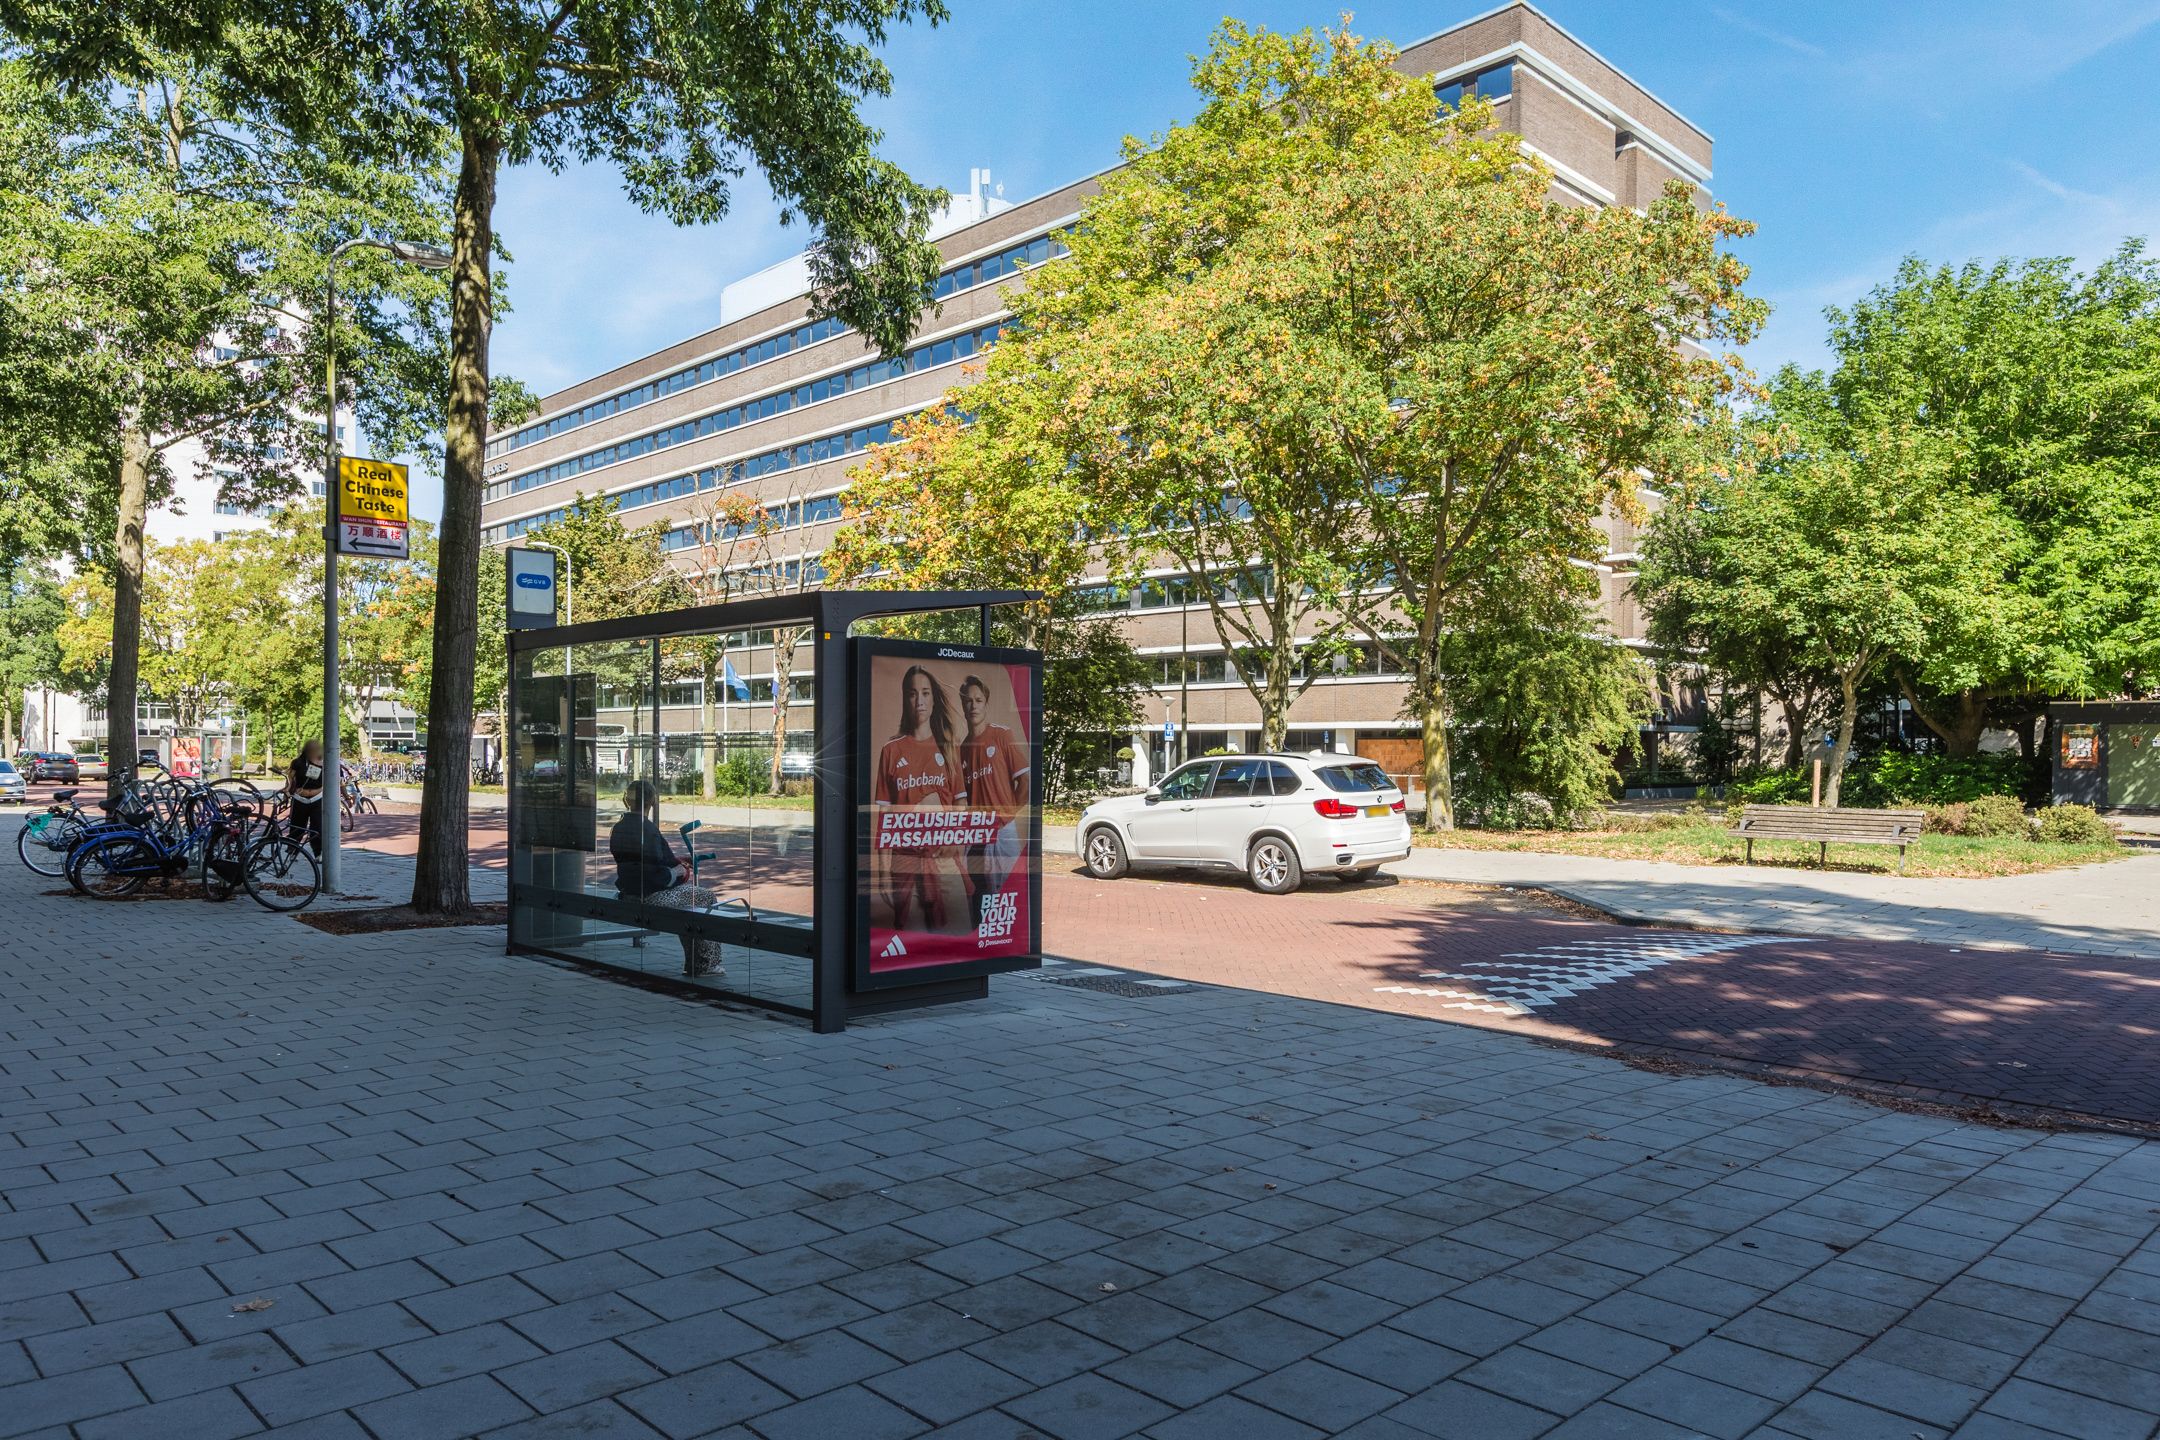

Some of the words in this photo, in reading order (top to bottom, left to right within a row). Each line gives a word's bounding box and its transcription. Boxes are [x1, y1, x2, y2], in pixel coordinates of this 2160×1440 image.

[358, 466, 392, 482] Real
[345, 480, 404, 499] Chinese
[355, 497, 395, 513] Taste
[937, 648, 975, 659] JCDecaux
[896, 771, 945, 791] Rabobank
[882, 811, 969, 829] EXCLUSIEF
[970, 811, 996, 826] BIJ
[879, 828, 995, 848] PASSAHOCKEY
[981, 892, 1018, 909] BEAT
[980, 906, 1017, 923] YOUR
[978, 920, 1015, 938] BEST
